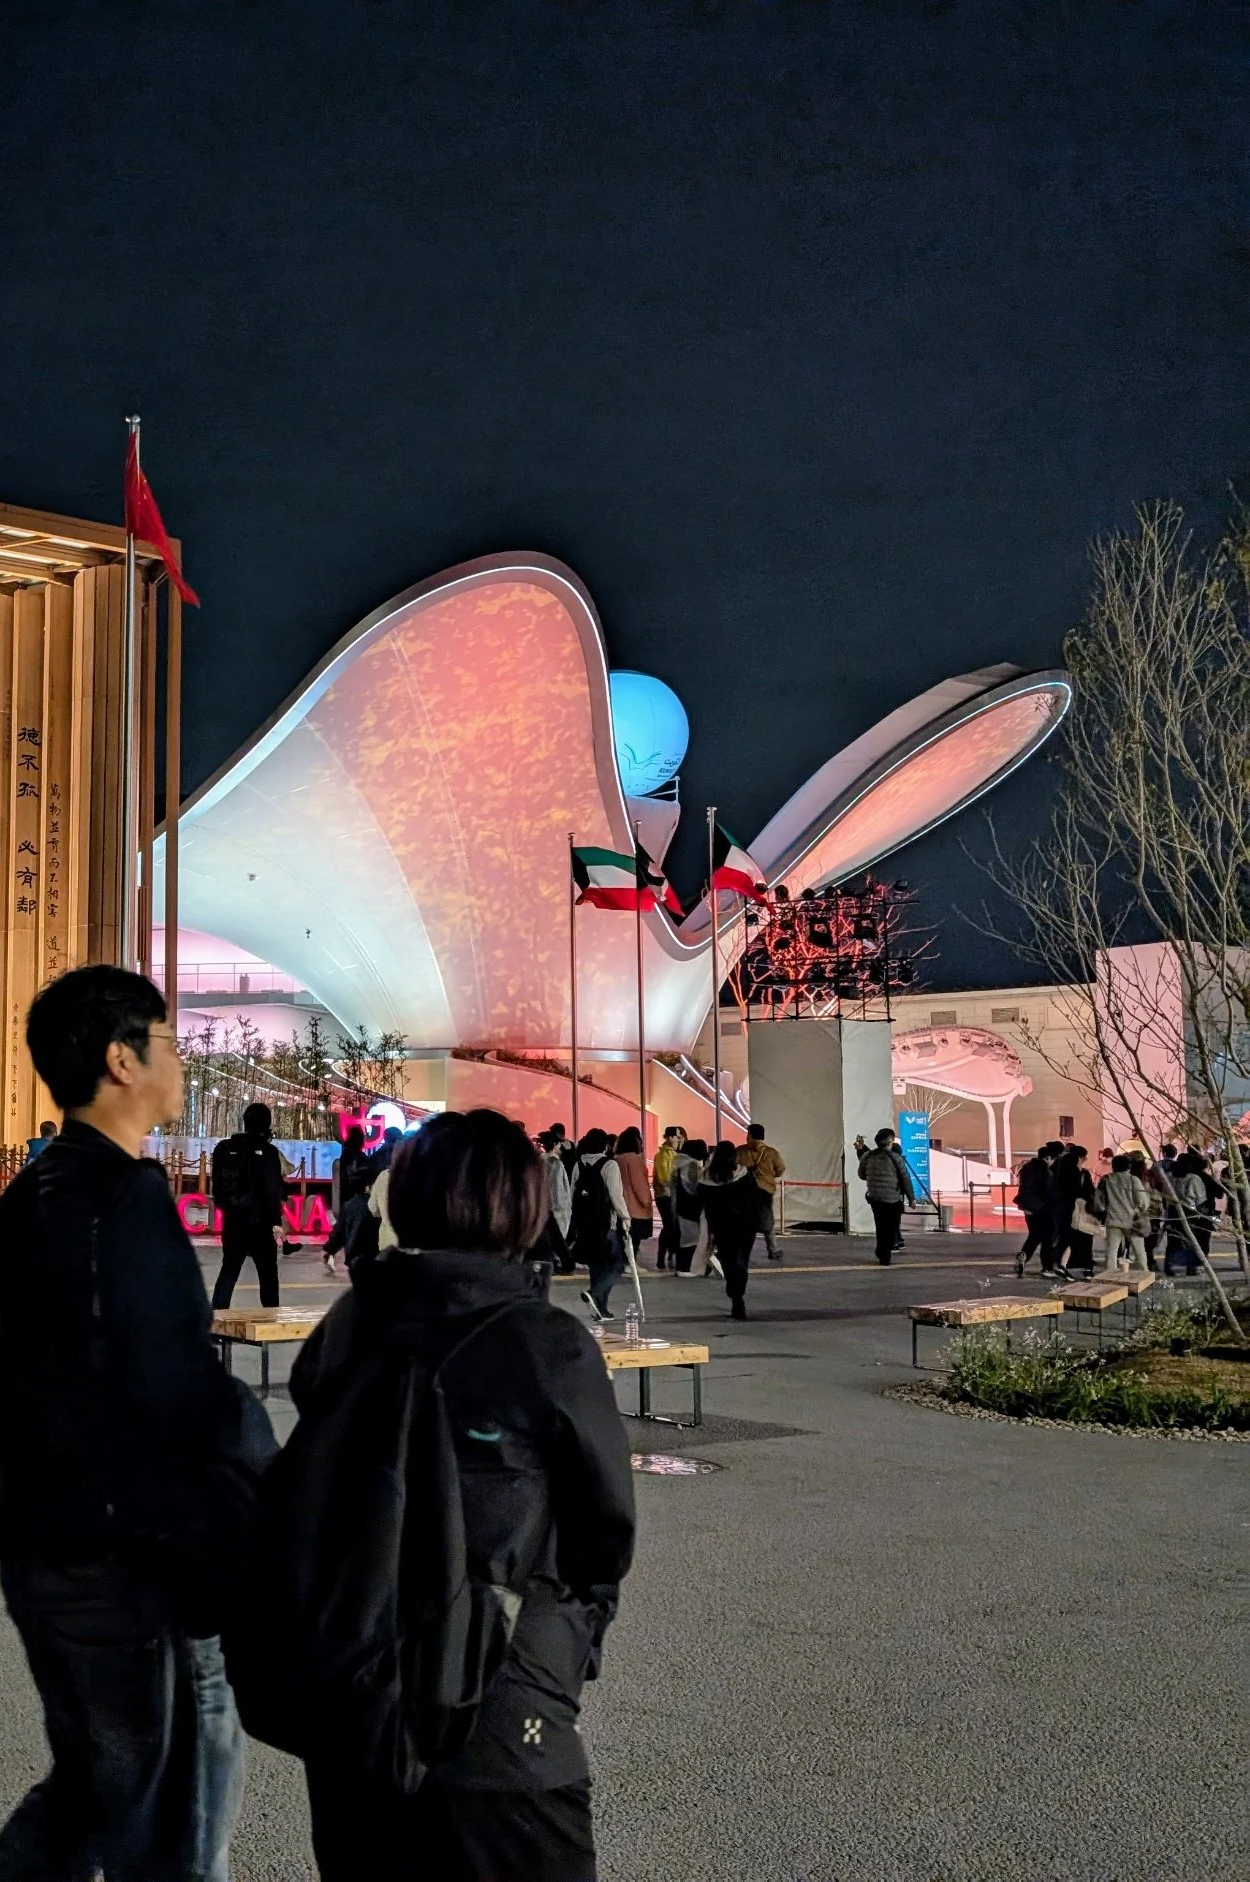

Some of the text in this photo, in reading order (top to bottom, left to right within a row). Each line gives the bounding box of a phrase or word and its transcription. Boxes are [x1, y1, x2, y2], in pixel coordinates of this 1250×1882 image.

[16, 727, 42, 798] 德不孤
[176, 1192, 333, 1233] CNA
